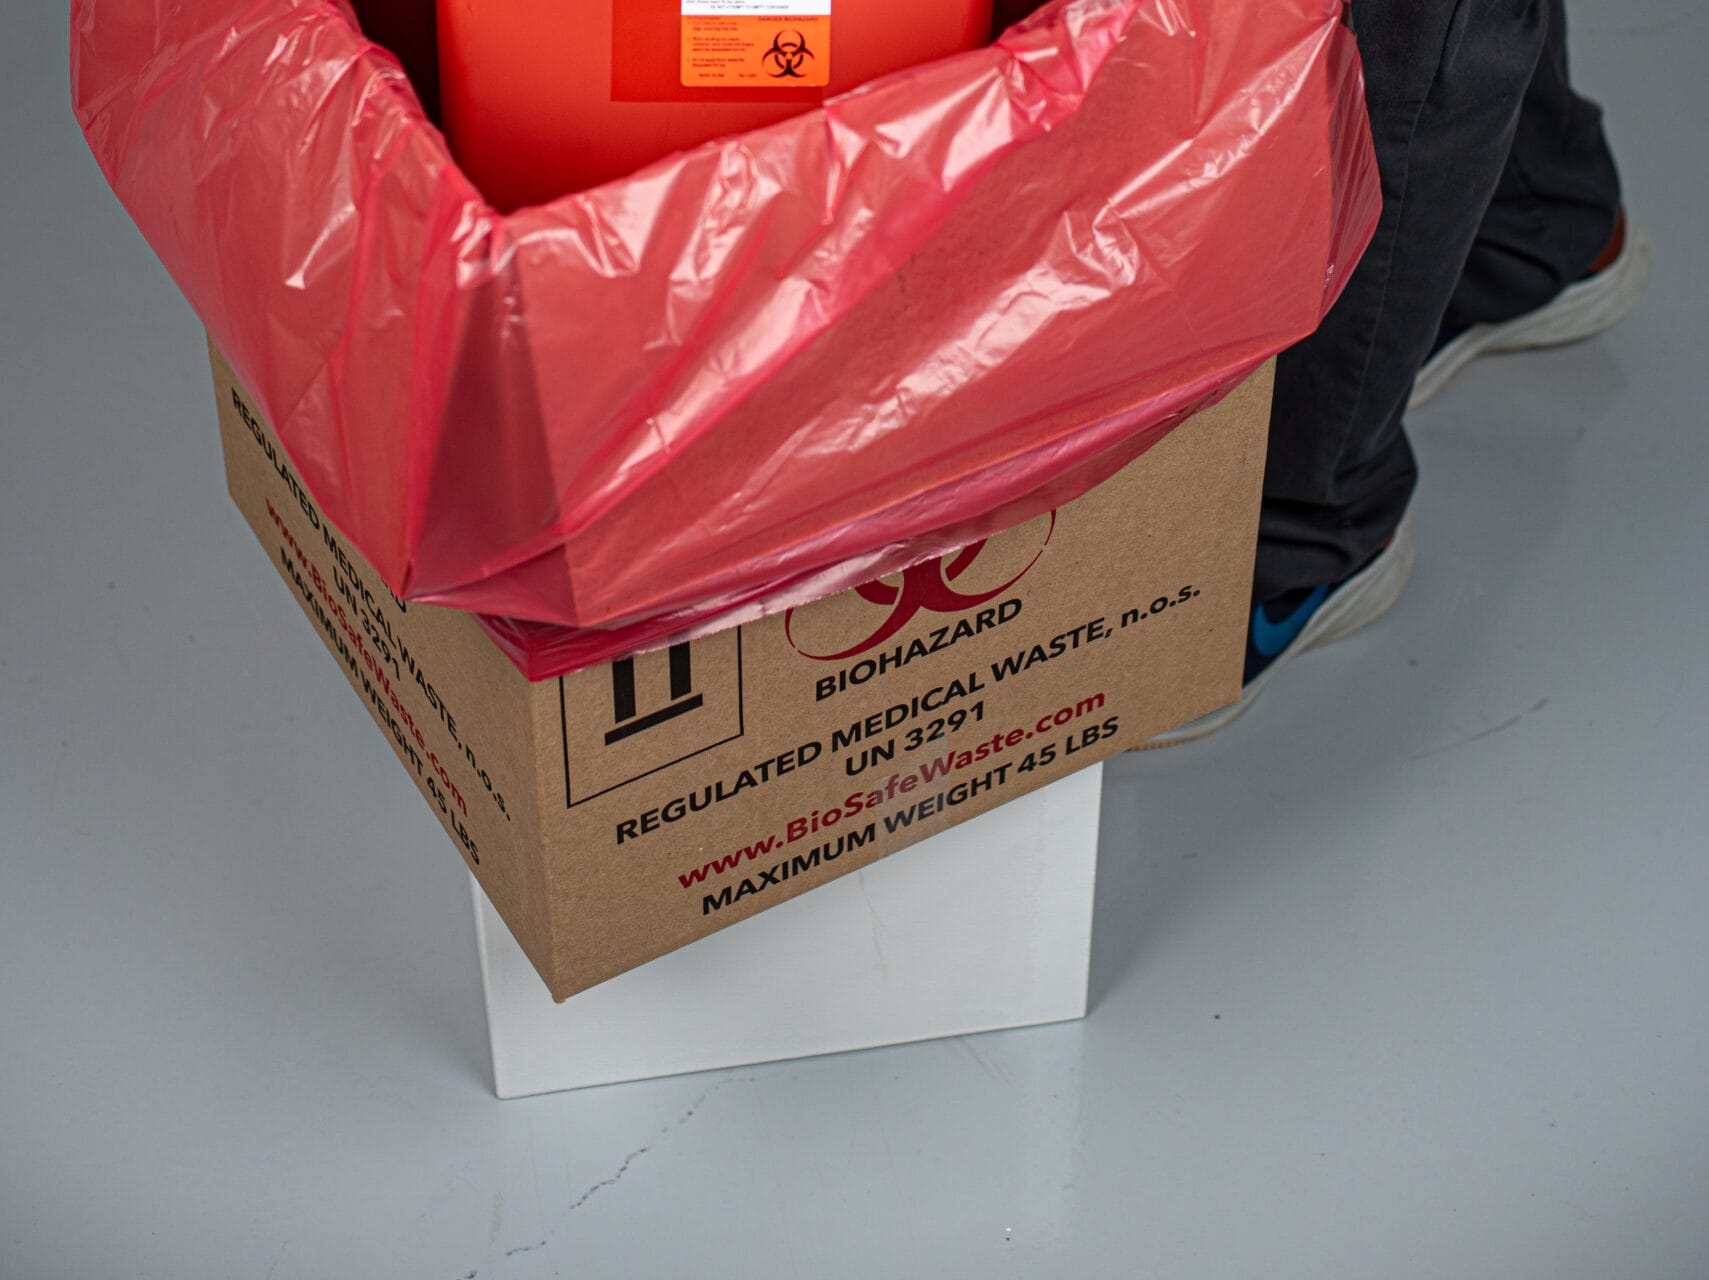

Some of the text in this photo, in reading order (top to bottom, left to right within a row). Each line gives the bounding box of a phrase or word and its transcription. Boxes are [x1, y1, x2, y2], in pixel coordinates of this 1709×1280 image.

[231, 386, 320, 531] REGULATED
[322, 523, 398, 651] MEDICAL
[398, 634, 463, 750] WASTE,
[265, 497, 468, 818] www.BioSafeWaste.com
[333, 565, 357, 617] UN
[360, 607, 401, 681] 3291
[814, 597, 1023, 703] BIOHAZARD
[280, 546, 360, 679] MAXIMUM
[360, 668, 423, 777] WEIGHT
[426, 775, 448, 815] 45
[450, 807, 480, 866] LBS
[615, 584, 1201, 846] REGULATED MEDICAL WASTE, n.o.s.
[677, 691, 1106, 890] www.BioSafeWaste.com
[845, 699, 985, 777] UN 3291
[702, 714, 1121, 916] MAXIMUM WEIGHT 45 LBS
